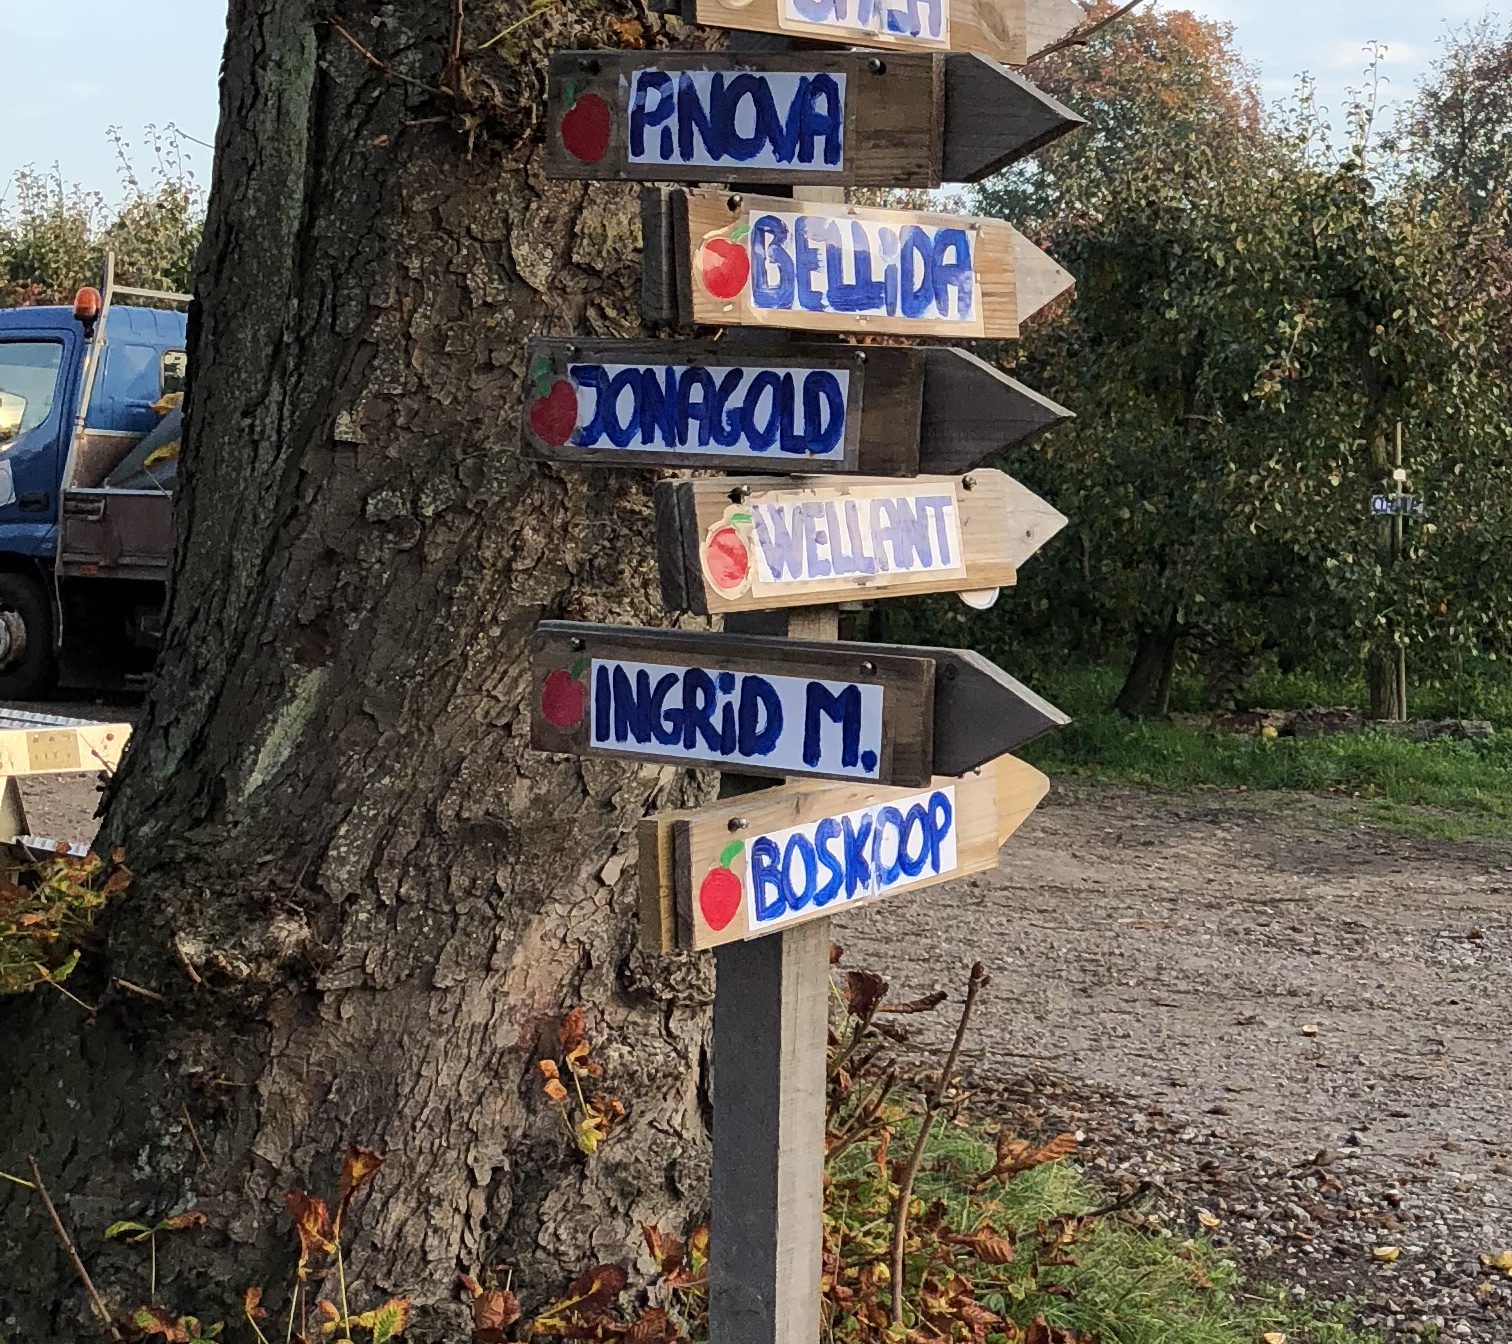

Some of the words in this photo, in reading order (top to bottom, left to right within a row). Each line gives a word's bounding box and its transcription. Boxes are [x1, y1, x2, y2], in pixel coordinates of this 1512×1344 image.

[629, 71, 841, 164] PINOVA
[751, 214, 974, 320] BELLiDA
[568, 364, 844, 454] JONAGOLD
[752, 495, 953, 581] WELLANT
[595, 664, 783, 757] INGRiD
[802, 681, 877, 773] M.
[751, 790, 953, 923] BOSKOOP
